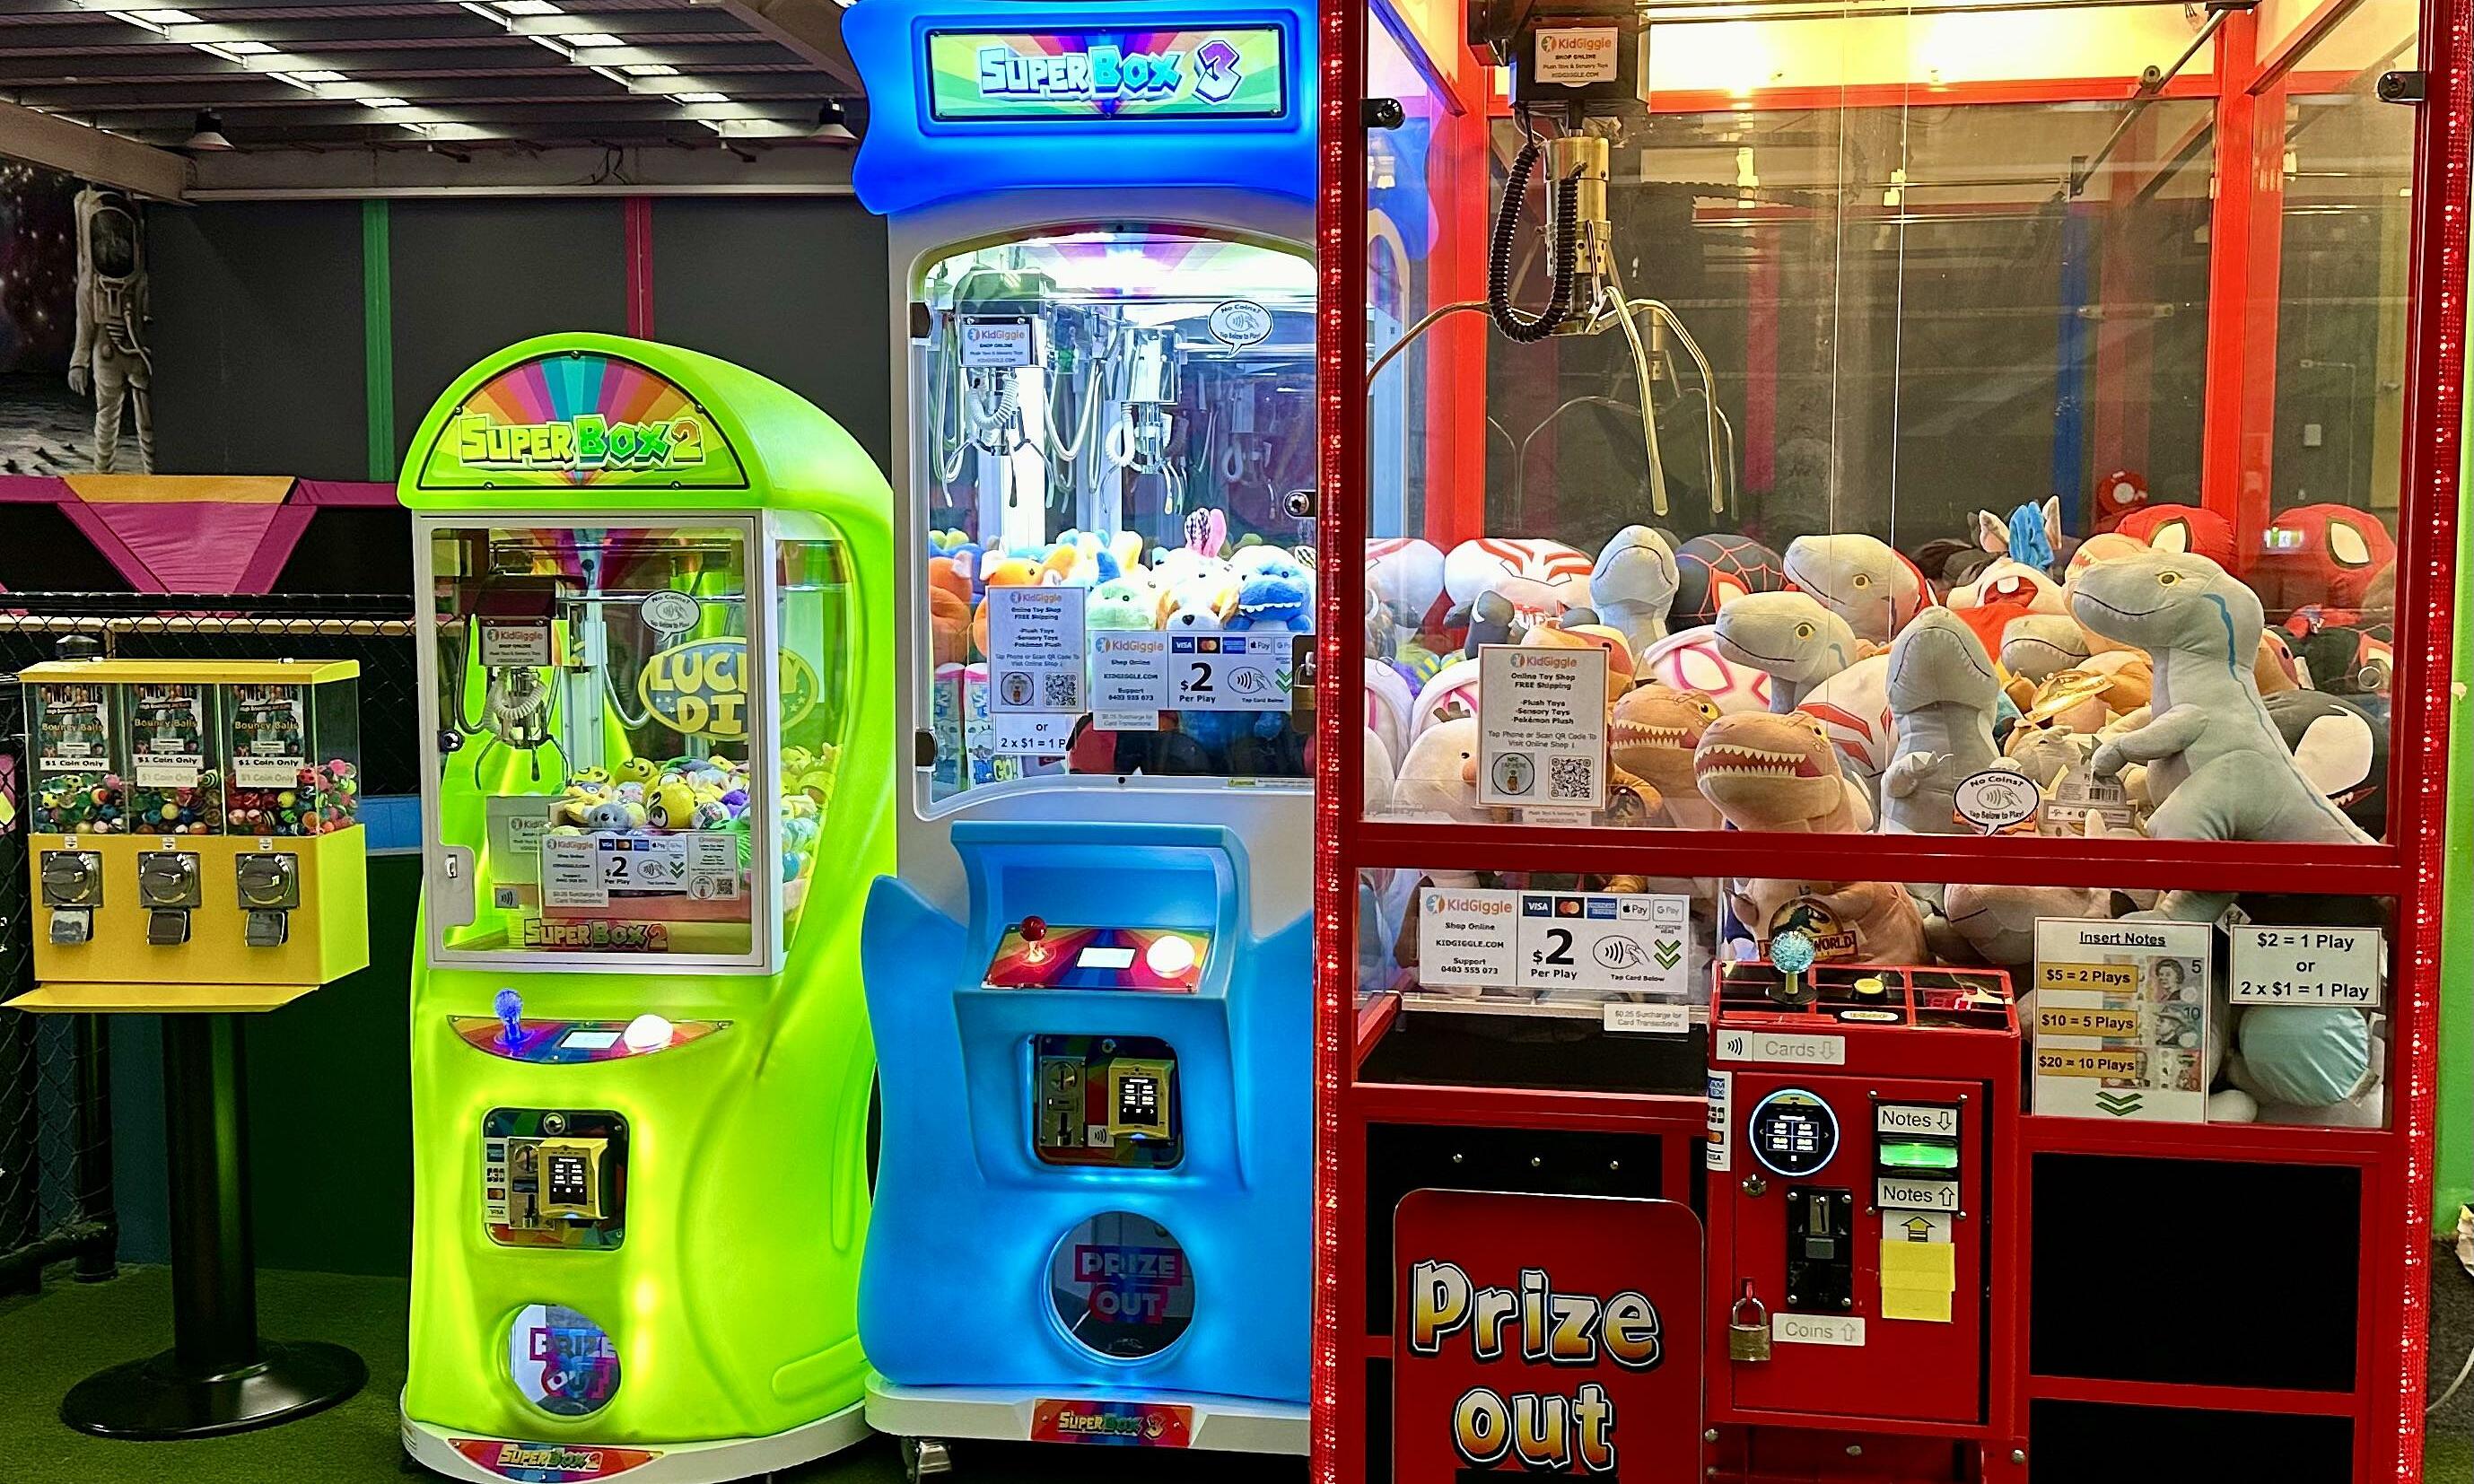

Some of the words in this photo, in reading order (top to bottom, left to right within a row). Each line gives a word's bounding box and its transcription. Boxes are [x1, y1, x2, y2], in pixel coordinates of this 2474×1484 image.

[1558, 38, 1612, 50] KidGiggle
[1194, 40, 1242, 102] 3
[982, 330, 1025, 340] KidGiggle
[670, 416, 706, 463] 2
[1023, 594, 1062, 603] KidGiggle
[501, 632, 543, 642] KidGiggle
[1113, 641, 1163, 652] KidGiggle
[1526, 657, 1578, 668] KidGiggle
[650, 651, 803, 694] LUCY
[1181, 662, 1212, 692] $2
[1197, 695, 1216, 703] Play
[235, 721, 271, 730] Bouncy
[1036, 723, 1048, 731] or
[1001, 738, 1007, 747] 2
[1021, 738, 1033, 748] $1
[1049, 738, 1053, 747] 1
[1555, 732, 1566, 740] QR
[83, 760, 103, 768] Only
[176, 757, 197, 765] Only
[1989, 776, 2024, 787] Coins?
[1981, 810, 1999, 819] Below
[1448, 899, 1512, 914] KidGiggle
[1527, 902, 1548, 911] VISA
[1632, 904, 1648, 915] Pay
[1666, 907, 1679, 915] Pay
[647, 924, 669, 951] 2
[1436, 939, 1504, 947] KIDGIGGLE.COM
[1814, 935, 1852, 951] WORLD
[2080, 931, 2121, 945] Insert
[2126, 932, 2165, 947] Notes
[2258, 933, 2277, 948] $2
[2301, 935, 2308, 947] 1
[2317, 935, 2354, 951] Play
[1533, 929, 1574, 965] $2
[1453, 957, 1486, 965] Support
[2191, 959, 2201, 973] 5
[2296, 961, 2315, 972] or
[1531, 969, 1550, 977] Per
[1554, 969, 1577, 980] Play
[2046, 969, 2063, 982] $5
[2079, 969, 2088, 982] 2
[2093, 970, 2130, 986] Plays
[2241, 982, 2251, 994] 2
[2257, 984, 2266, 994] x
[2272, 981, 2291, 996] $1
[2316, 983, 2323, 996] 1
[2331, 983, 2369, 1000] Play
[2183, 1007, 2200, 1020] 10
[2041, 1015, 2067, 1028] $10
[2084, 1016, 2091, 1027] 5
[2097, 1016, 2134, 1032] Plays
[1766, 1041, 1815, 1057] Cards
[2039, 1056, 2062, 1069] $20
[2079, 1057, 2094, 1069] 10
[2098, 1058, 2135, 1073] Plays
[1883, 1111, 1931, 1127] Notes
[1884, 1186, 1932, 1202] Notes
[1081, 1253, 1176, 1278] PRIZE
[1097, 1290, 1160, 1316] OUT
[1413, 1261, 1658, 1366] Prize
[1786, 1323, 1832, 1338] Coins
[1456, 1384, 1613, 1471] out
